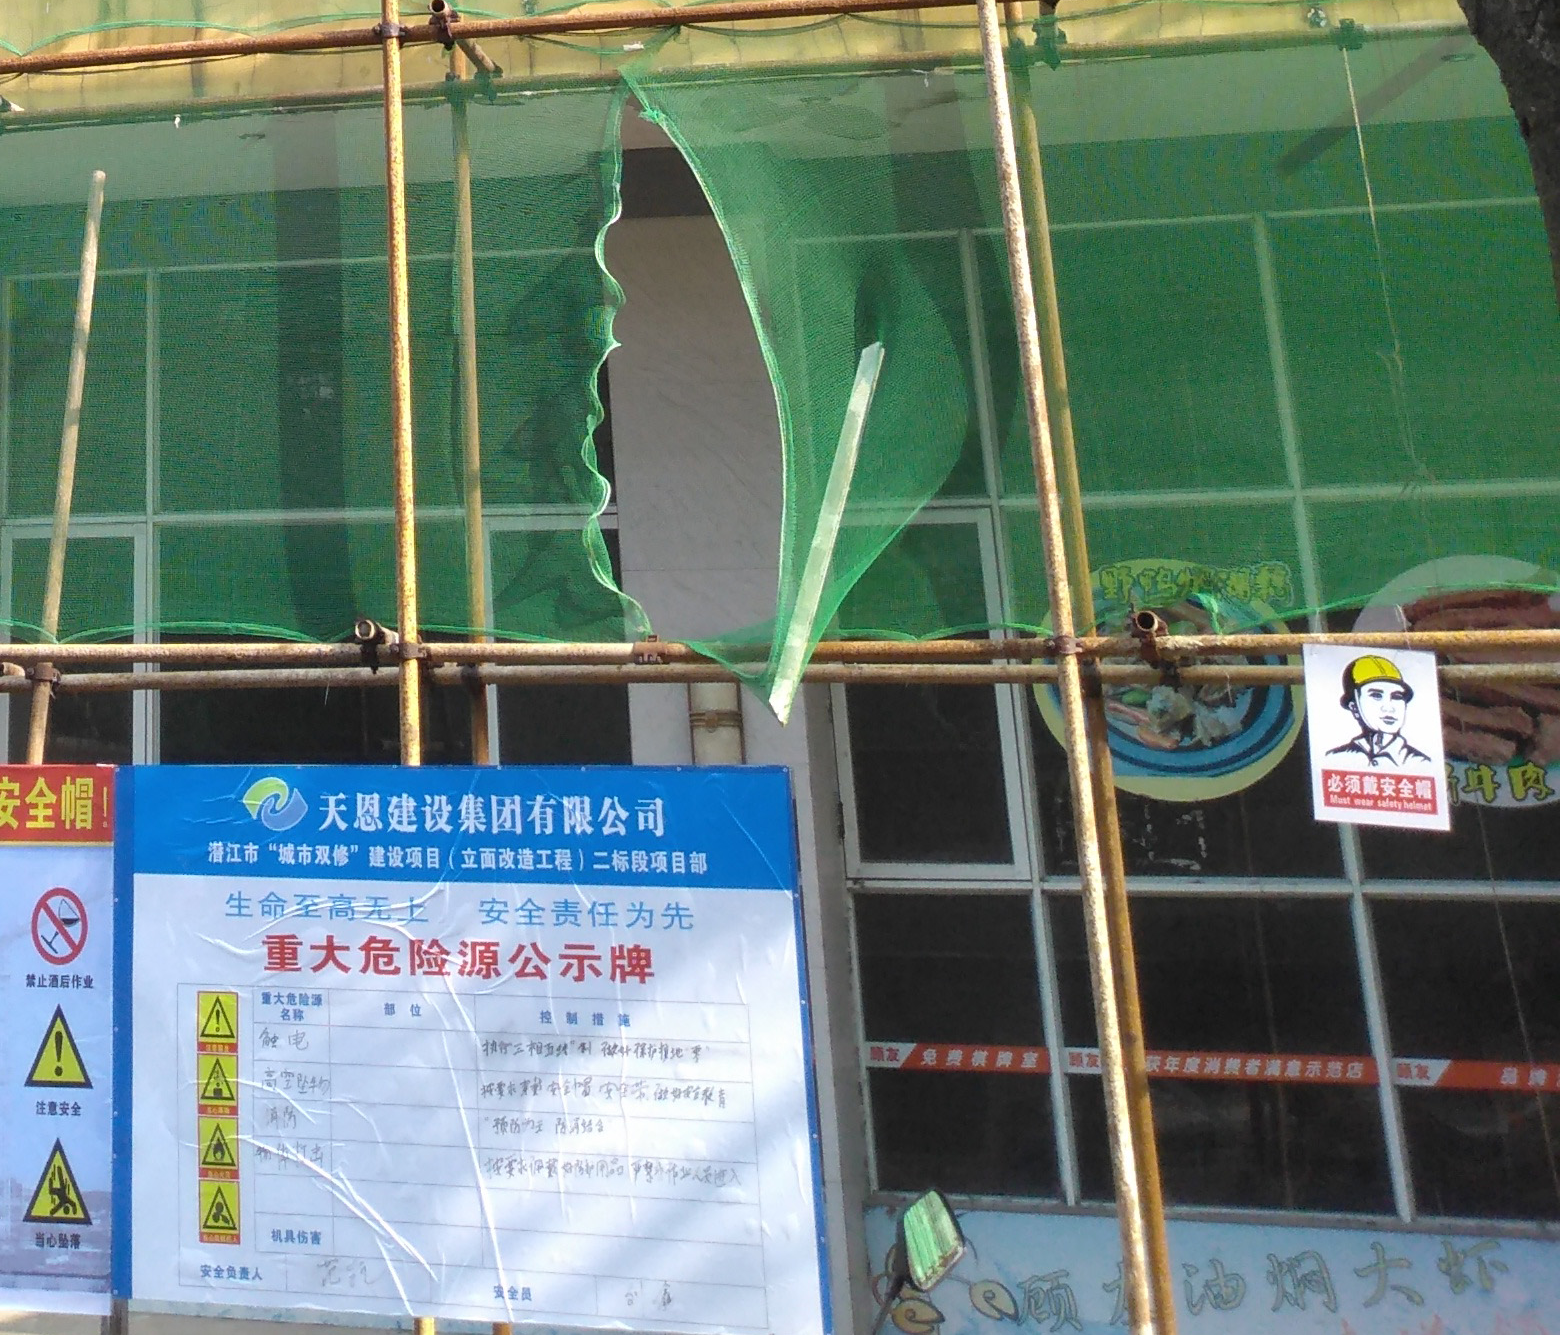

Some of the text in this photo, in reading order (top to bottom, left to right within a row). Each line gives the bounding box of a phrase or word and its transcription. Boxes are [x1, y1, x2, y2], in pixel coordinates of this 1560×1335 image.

[1327, 773, 1433, 800] 必须戴安全帽
[1329, 794, 1433, 812] Must wear safety helmet
[318, 792, 665, 837] 天恩建设集团有限公司
[225, 891, 695, 931] 生命至高无上 安全责任为先
[261, 933, 655, 985] 重大危险源公示牌
[25, 974, 94, 989] 禁止酒后作业
[261, 991, 323, 1007] 重大危险源
[280, 1008, 305, 1022] 名称
[383, 1002, 422, 1017] 部位
[539, 1009, 632, 1028] 控制措施
[920, 1049, 1040, 1069] 免费棋牌室
[35, 1100, 82, 1116] 注意安全
[35, 1232, 81, 1249] 当心坠落
[271, 1228, 323, 1246] 机具伤害
[199, 1264, 264, 1282] 安全负责人
[493, 1285, 533, 1302] 安全员
